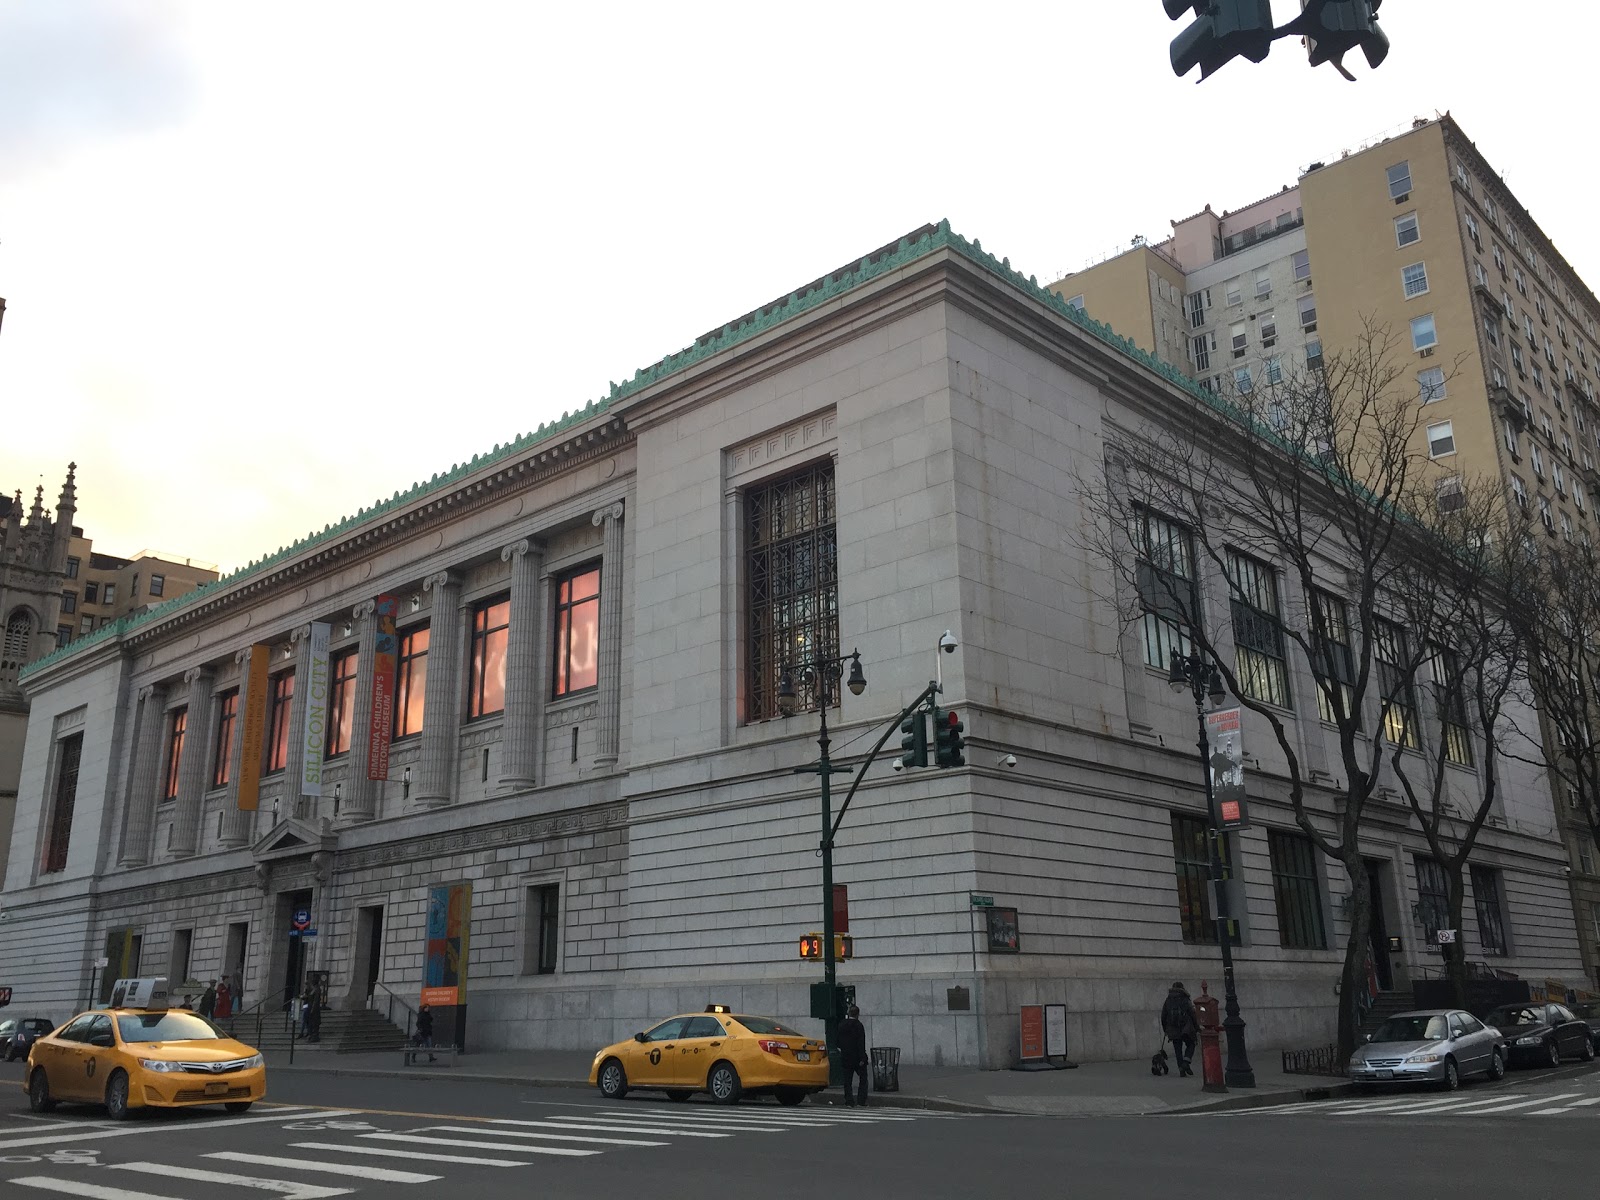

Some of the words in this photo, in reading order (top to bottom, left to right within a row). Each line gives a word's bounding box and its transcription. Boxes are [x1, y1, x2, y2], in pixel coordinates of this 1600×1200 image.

[311, 656, 327, 701] CITY
[373, 675, 384, 730] CHILDREN'S
[381, 694, 391, 737] MUSEUM
[306, 705, 324, 784] SILICON
[370, 731, 381, 779] DIMENNA
[379, 739, 389, 779] HISTORY
[812, 939, 818, 955] 9
